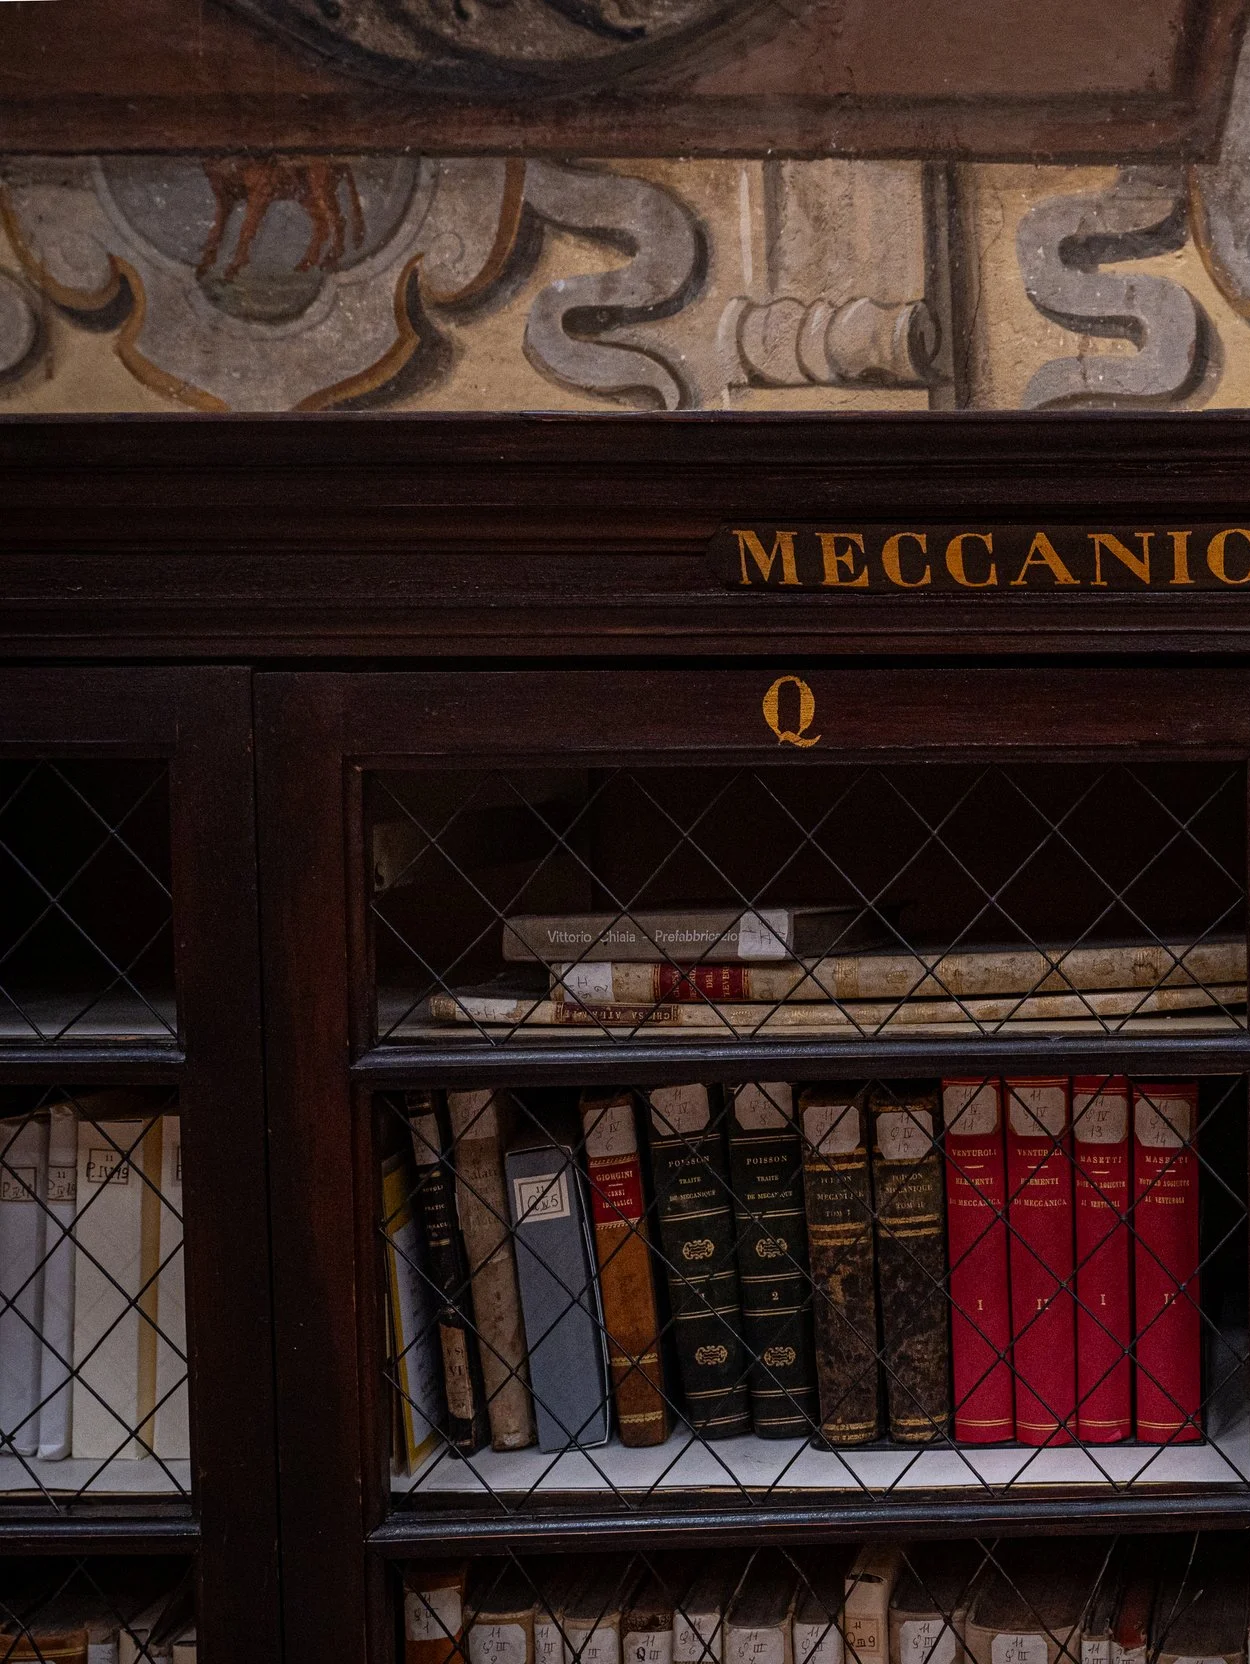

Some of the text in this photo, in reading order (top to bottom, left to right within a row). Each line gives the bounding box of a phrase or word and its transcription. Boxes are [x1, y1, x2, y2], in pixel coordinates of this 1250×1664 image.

[762, 675, 822, 748] Q
[547, 929, 592, 943] Vittorio
[600, 930, 636, 943] Chiaia
[655, 928, 739, 943] Prefabbricazio
[1030, 1089, 1041, 1101] 11
[1090, 1125, 1103, 1138] 13
[605, 1136, 614, 1151] 6
[951, 1148, 997, 1157] VENTUROLI
[746, 1154, 788, 1166] POISSON
[596, 1170, 633, 1182] GIORGINI
[1023, 1198, 1067, 1206] MECCANICA
[771, 1291, 780, 1301] 2
[1100, 1294, 1106, 1305] I
[977, 1299, 983, 1310] I
[489, 1627, 501, 1638] 11
[537, 1627, 550, 1638] 11
[807, 1626, 819, 1637] 11
[919, 1624, 930, 1634] 11
[642, 1635, 656, 1647] 11
[746, 1631, 759, 1641] 11
[1011, 1637, 1024, 1649] 11
[636, 1646, 662, 1662] Q III
